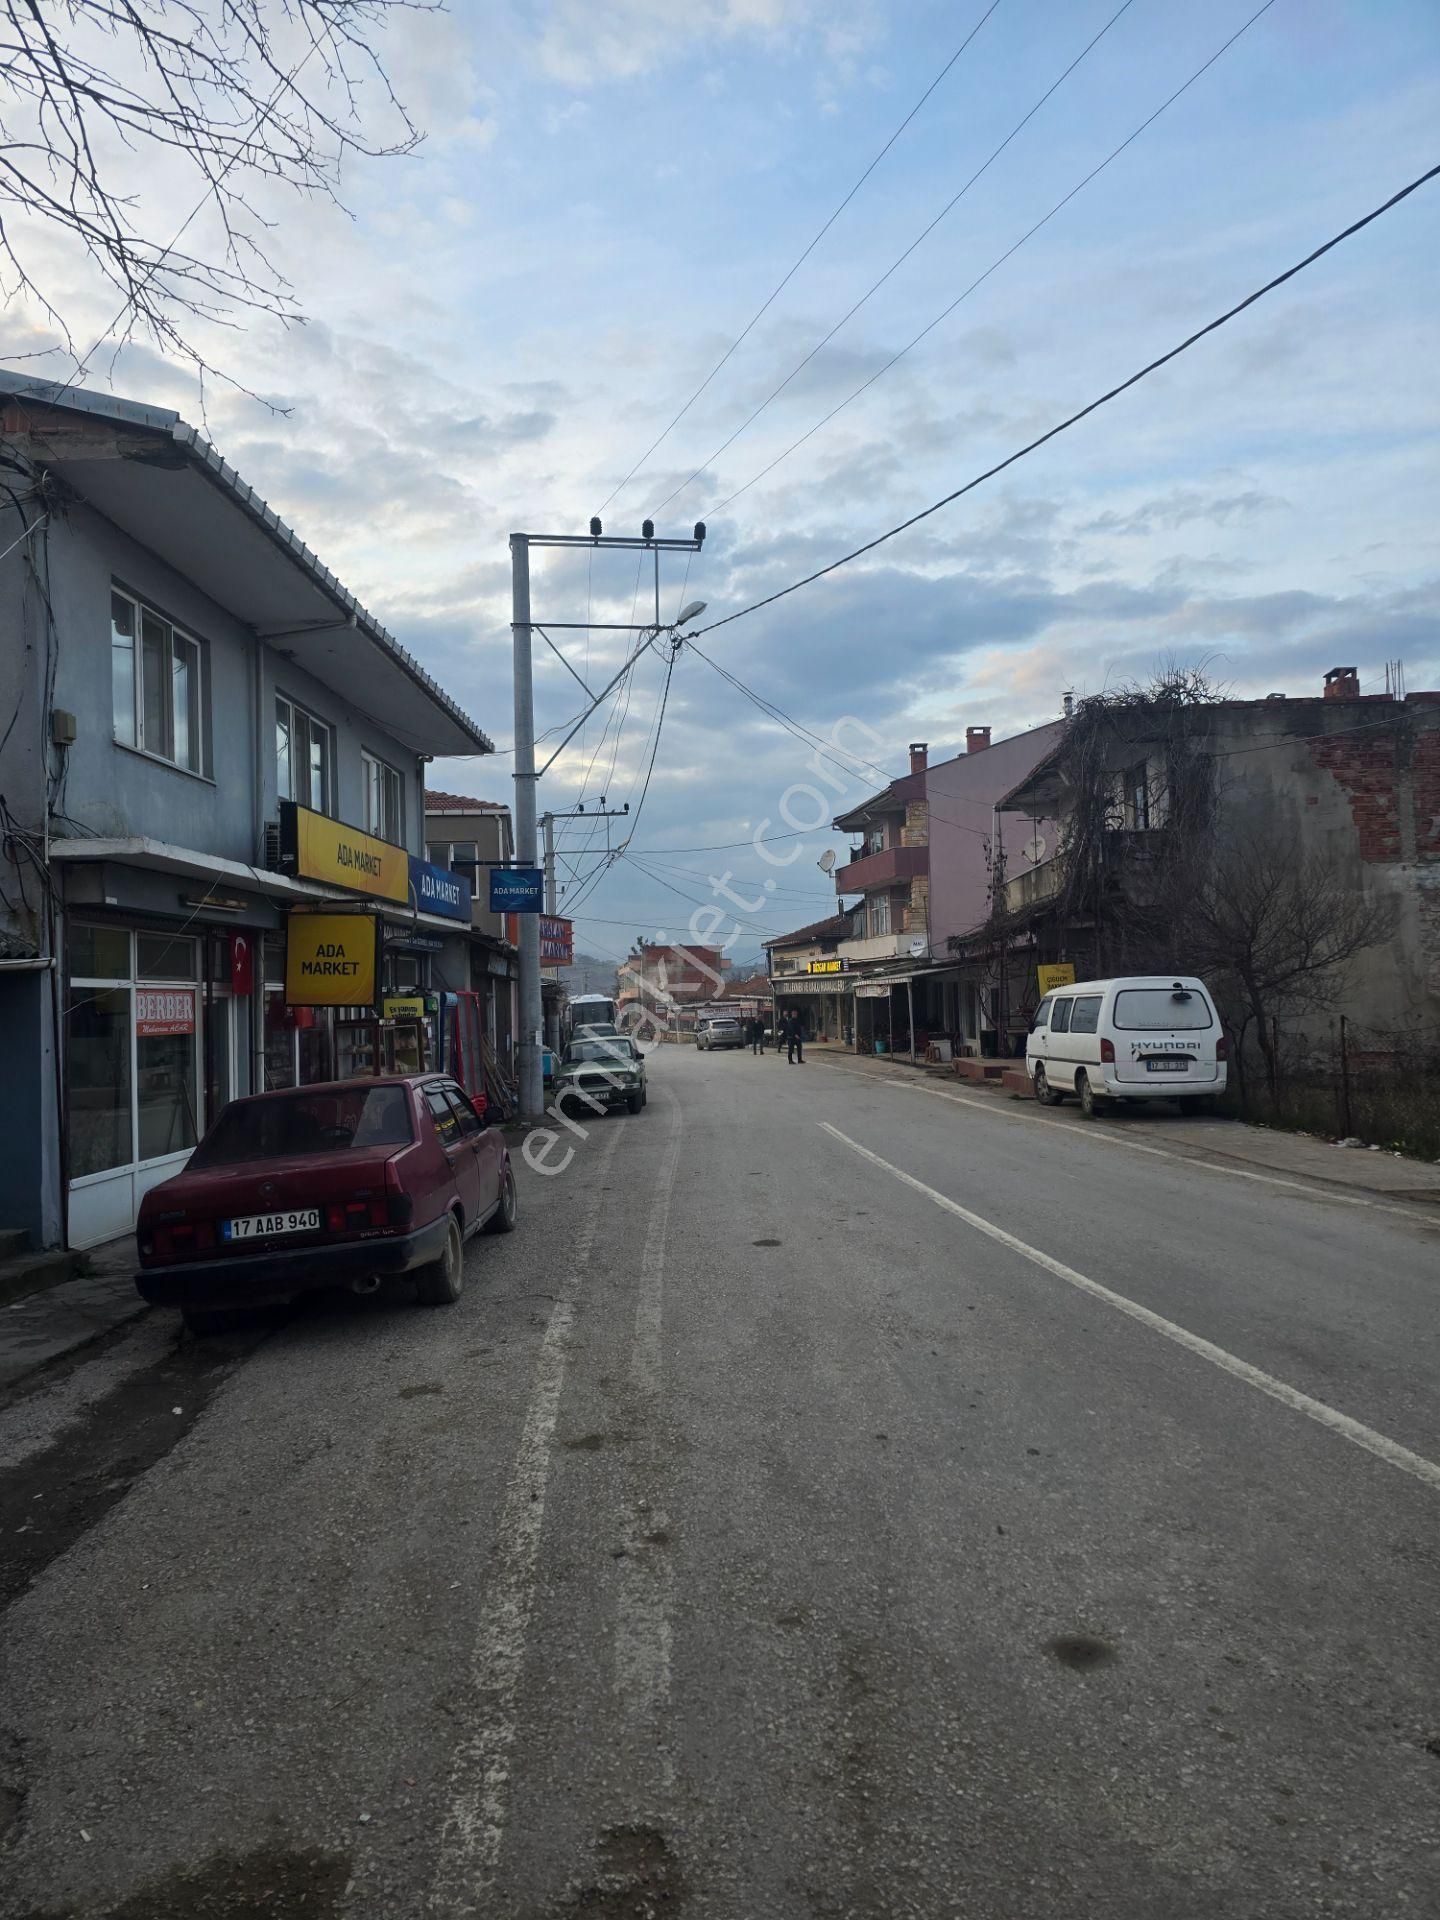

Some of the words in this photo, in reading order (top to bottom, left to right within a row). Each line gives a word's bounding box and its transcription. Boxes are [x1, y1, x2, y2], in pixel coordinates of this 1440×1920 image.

[337, 843, 353, 867] ADA
[354, 850, 382, 878] MARKET
[421, 874, 435, 897] ADA
[436, 879, 460, 905] MARKET
[493, 887, 508, 895] ADA
[509, 887, 539, 895] MARKET
[316, 944, 346, 958] ADA
[302, 961, 360, 976] MARKET
[136, 993, 193, 1020] BERBER
[233, 1220, 250, 1236] 17
[256, 1217, 284, 1234] AAB
[289, 1211, 318, 1230] 940
